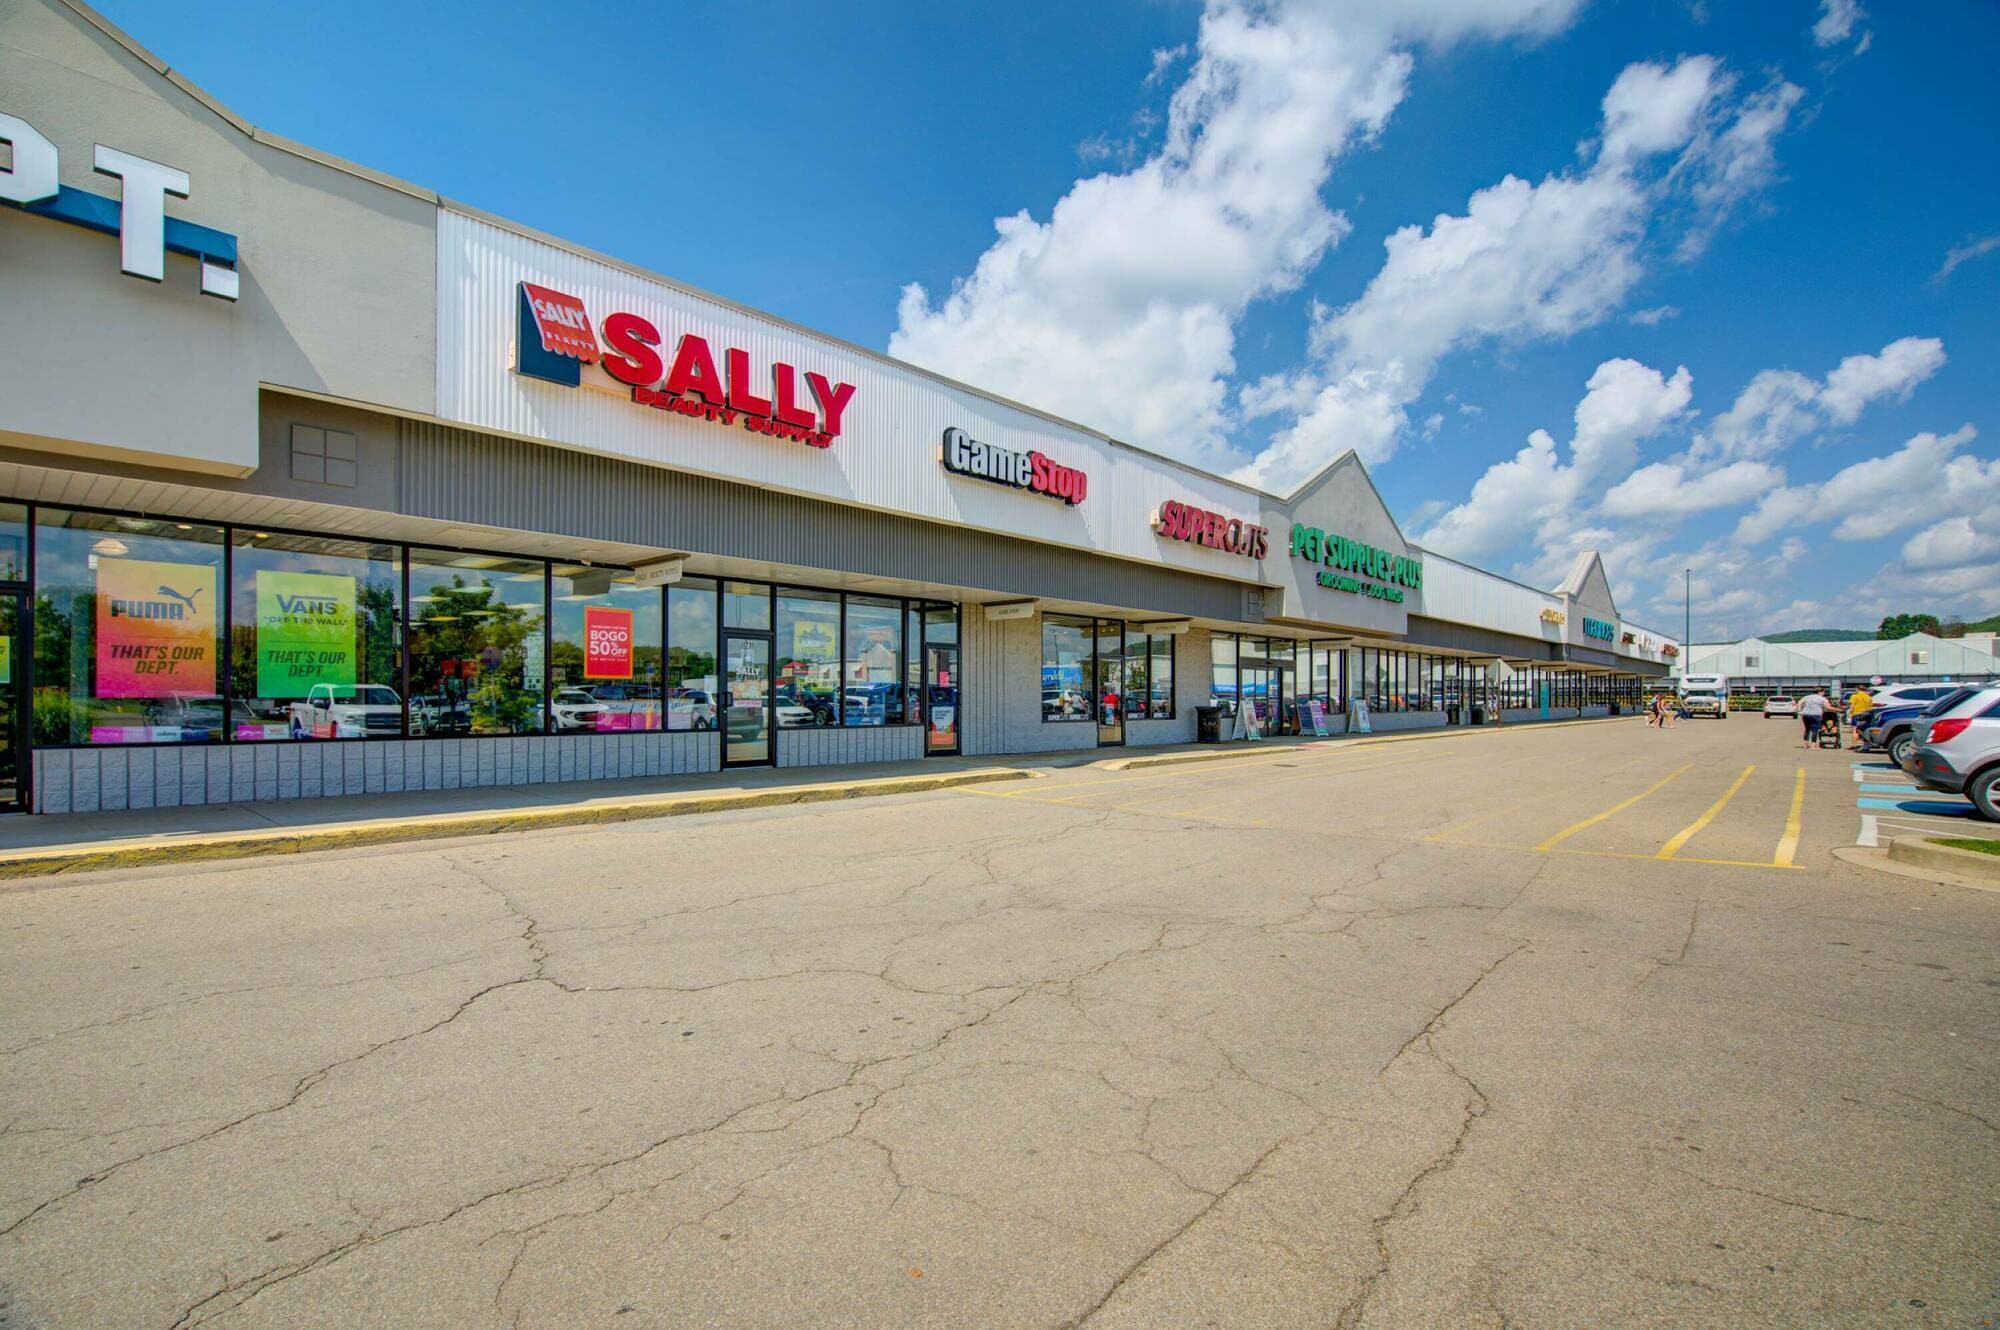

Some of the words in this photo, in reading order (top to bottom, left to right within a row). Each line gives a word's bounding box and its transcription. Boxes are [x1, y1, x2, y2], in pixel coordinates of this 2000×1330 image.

[534, 298, 585, 331] SALLY
[601, 312, 856, 436] SALLY
[632, 386, 739, 425] BEAUTY
[744, 416, 834, 448] SUPPLY
[944, 427, 1087, 505] GameStop
[1159, 500, 1268, 560] SUPERCUTS
[1290, 523, 1324, 562] PET
[1325, 534, 1392, 581] SUPPLIES
[1392, 555, 1423, 589] PLUS
[111, 600, 184, 620] PUMA
[276, 594, 338, 615] VANS
[292, 617, 314, 625] THE
[590, 630, 628, 641] BOGO
[111, 644, 168, 659] THAT'S
[171, 647, 204, 661] OUR
[267, 650, 316, 663] THAT'S
[319, 651, 347, 664] OUR
[134, 661, 179, 674] DEPT.
